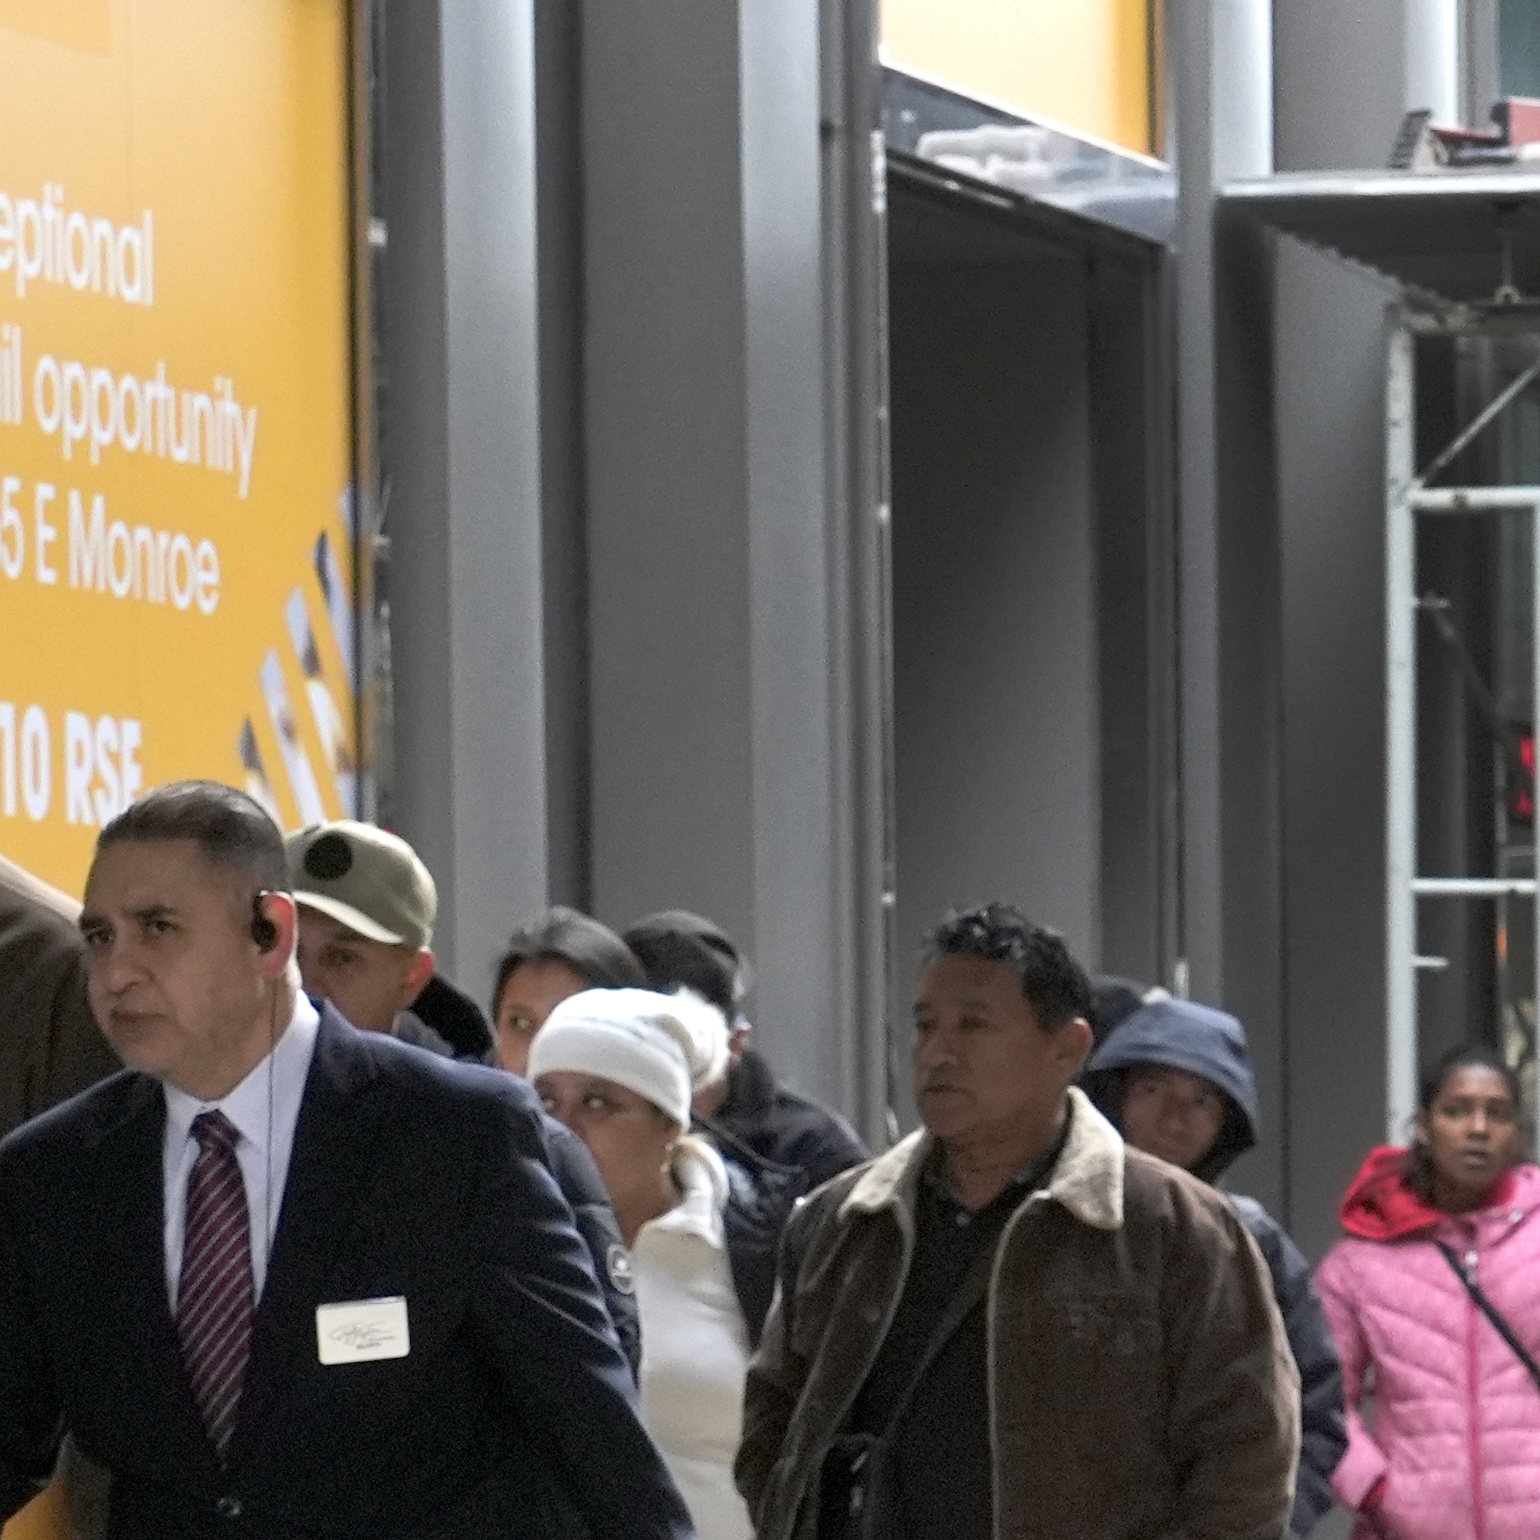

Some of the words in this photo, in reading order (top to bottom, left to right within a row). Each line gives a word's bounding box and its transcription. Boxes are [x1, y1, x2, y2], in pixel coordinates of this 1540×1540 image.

[35, 356, 256, 498] opportunity
[35, 482, 56, 586] E
[68, 487, 220, 615] Monroe
